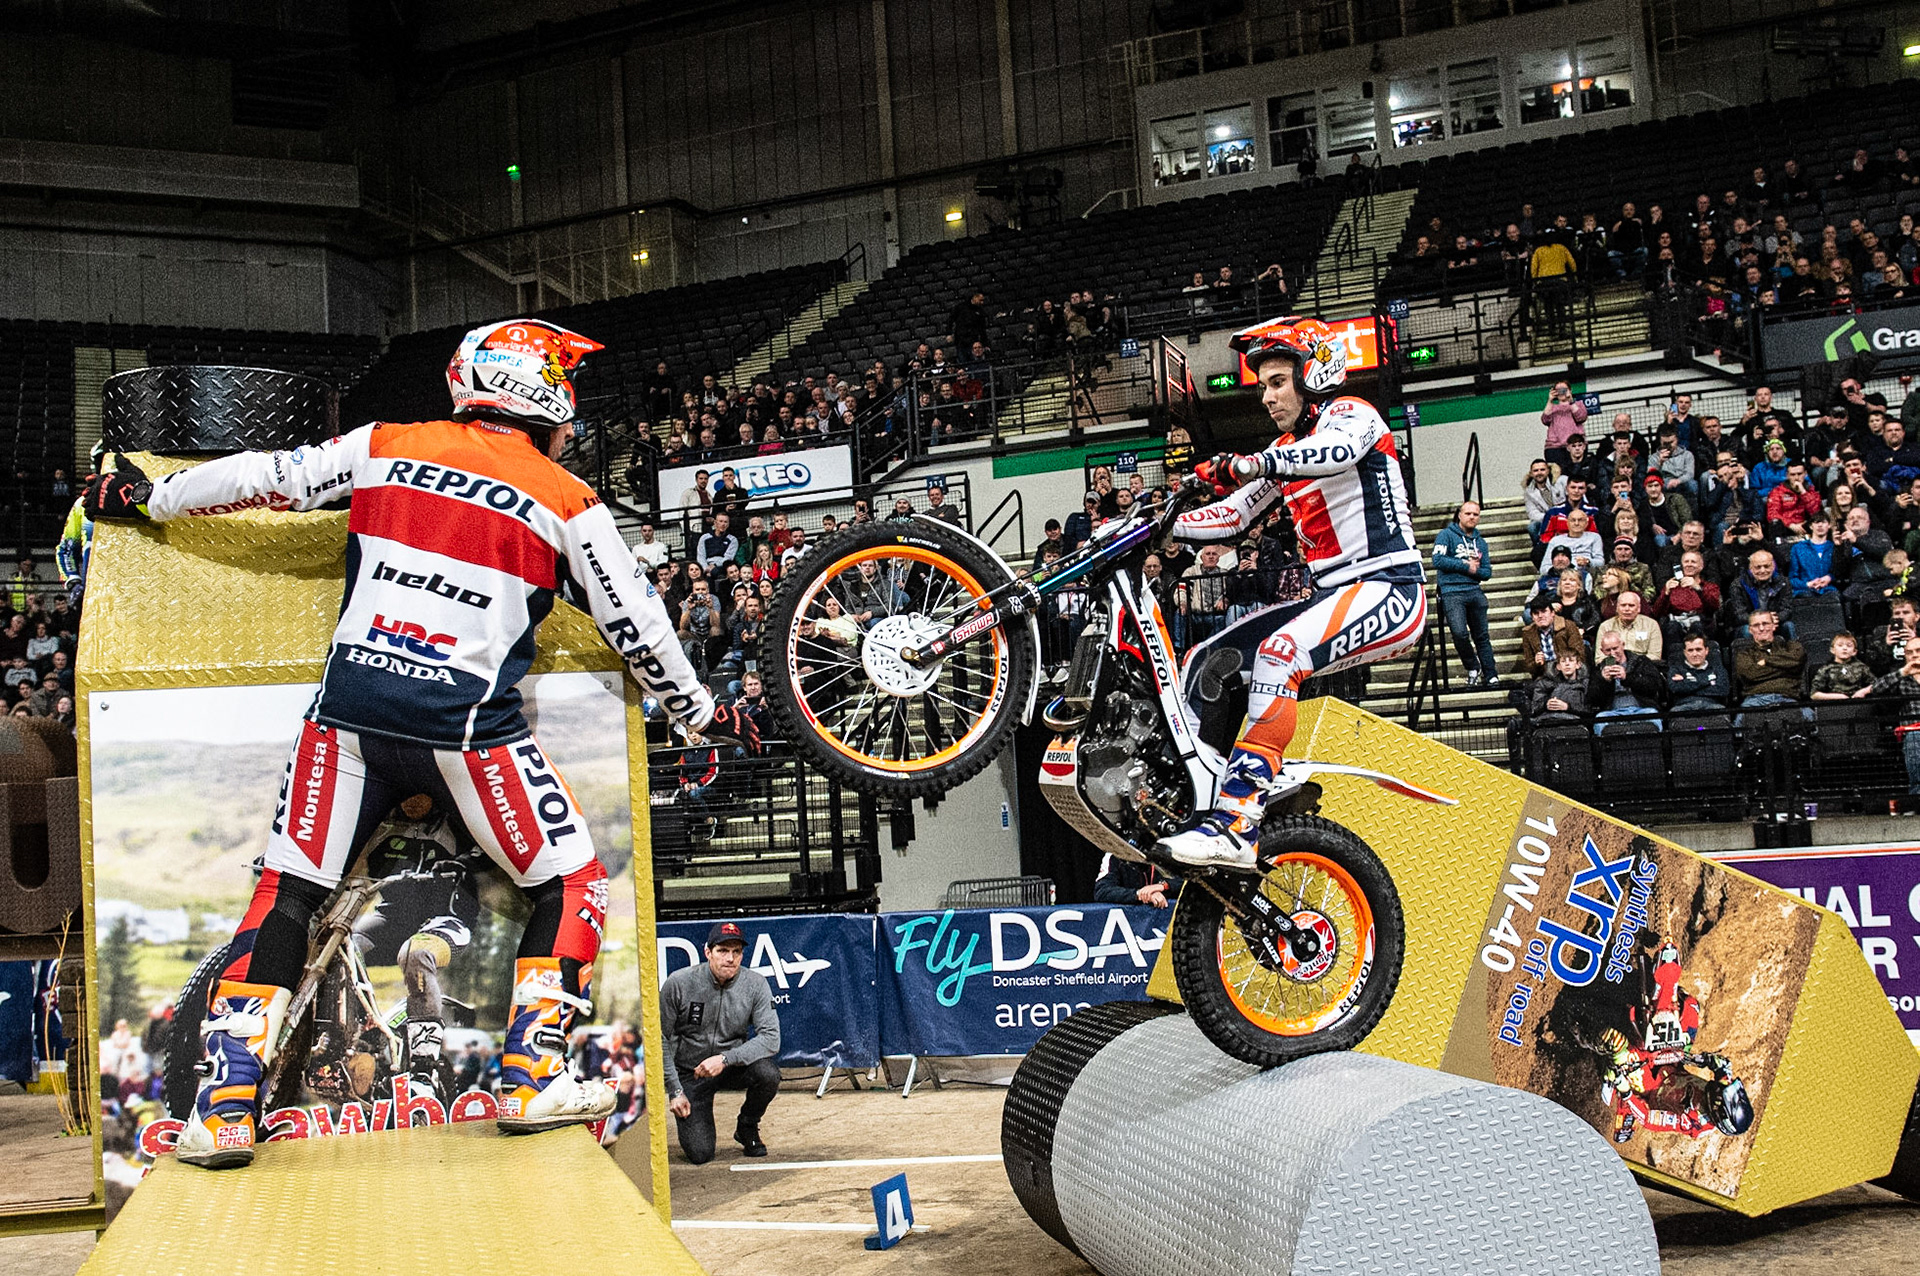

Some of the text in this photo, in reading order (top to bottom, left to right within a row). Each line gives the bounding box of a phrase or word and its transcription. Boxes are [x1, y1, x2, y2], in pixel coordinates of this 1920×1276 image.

[1390, 304, 1407, 312] 210
[1122, 342, 1137, 351] 211
[490, 371, 569, 420] hebo
[306, 470, 352, 498] heb
[1118, 456, 1134, 466] 110
[187, 490, 291, 517] HONDA
[386, 460, 535, 523] REPSOL
[1377, 471, 1395, 535] HONDA
[371, 561, 493, 610] hebo
[580, 542, 623, 609] hebo
[366, 614, 458, 662] HRC
[955, 612, 995, 644] SHOWA
[1329, 588, 1413, 663] REPSOL
[346, 647, 457, 687] HONDA
[1139, 620, 1172, 691] REPSOL
[1046, 751, 1072, 762] REPSOL
[296, 741, 328, 842] Montesa
[483, 763, 530, 856] Montesa
[1481, 815, 1558, 973] 10W-40
[1536, 833, 1636, 987] xrp
[1605, 860, 1658, 984] synthesis
[894, 908, 1148, 1007] Fly DSA
[993, 972, 1148, 987] Doncaster Sheffield Airport
[1338, 958, 1372, 1013] REPSOL
[1499, 939, 1549, 1047] off road
[995, 1001, 1091, 1028] aren
[886, 1188, 910, 1241] 4
